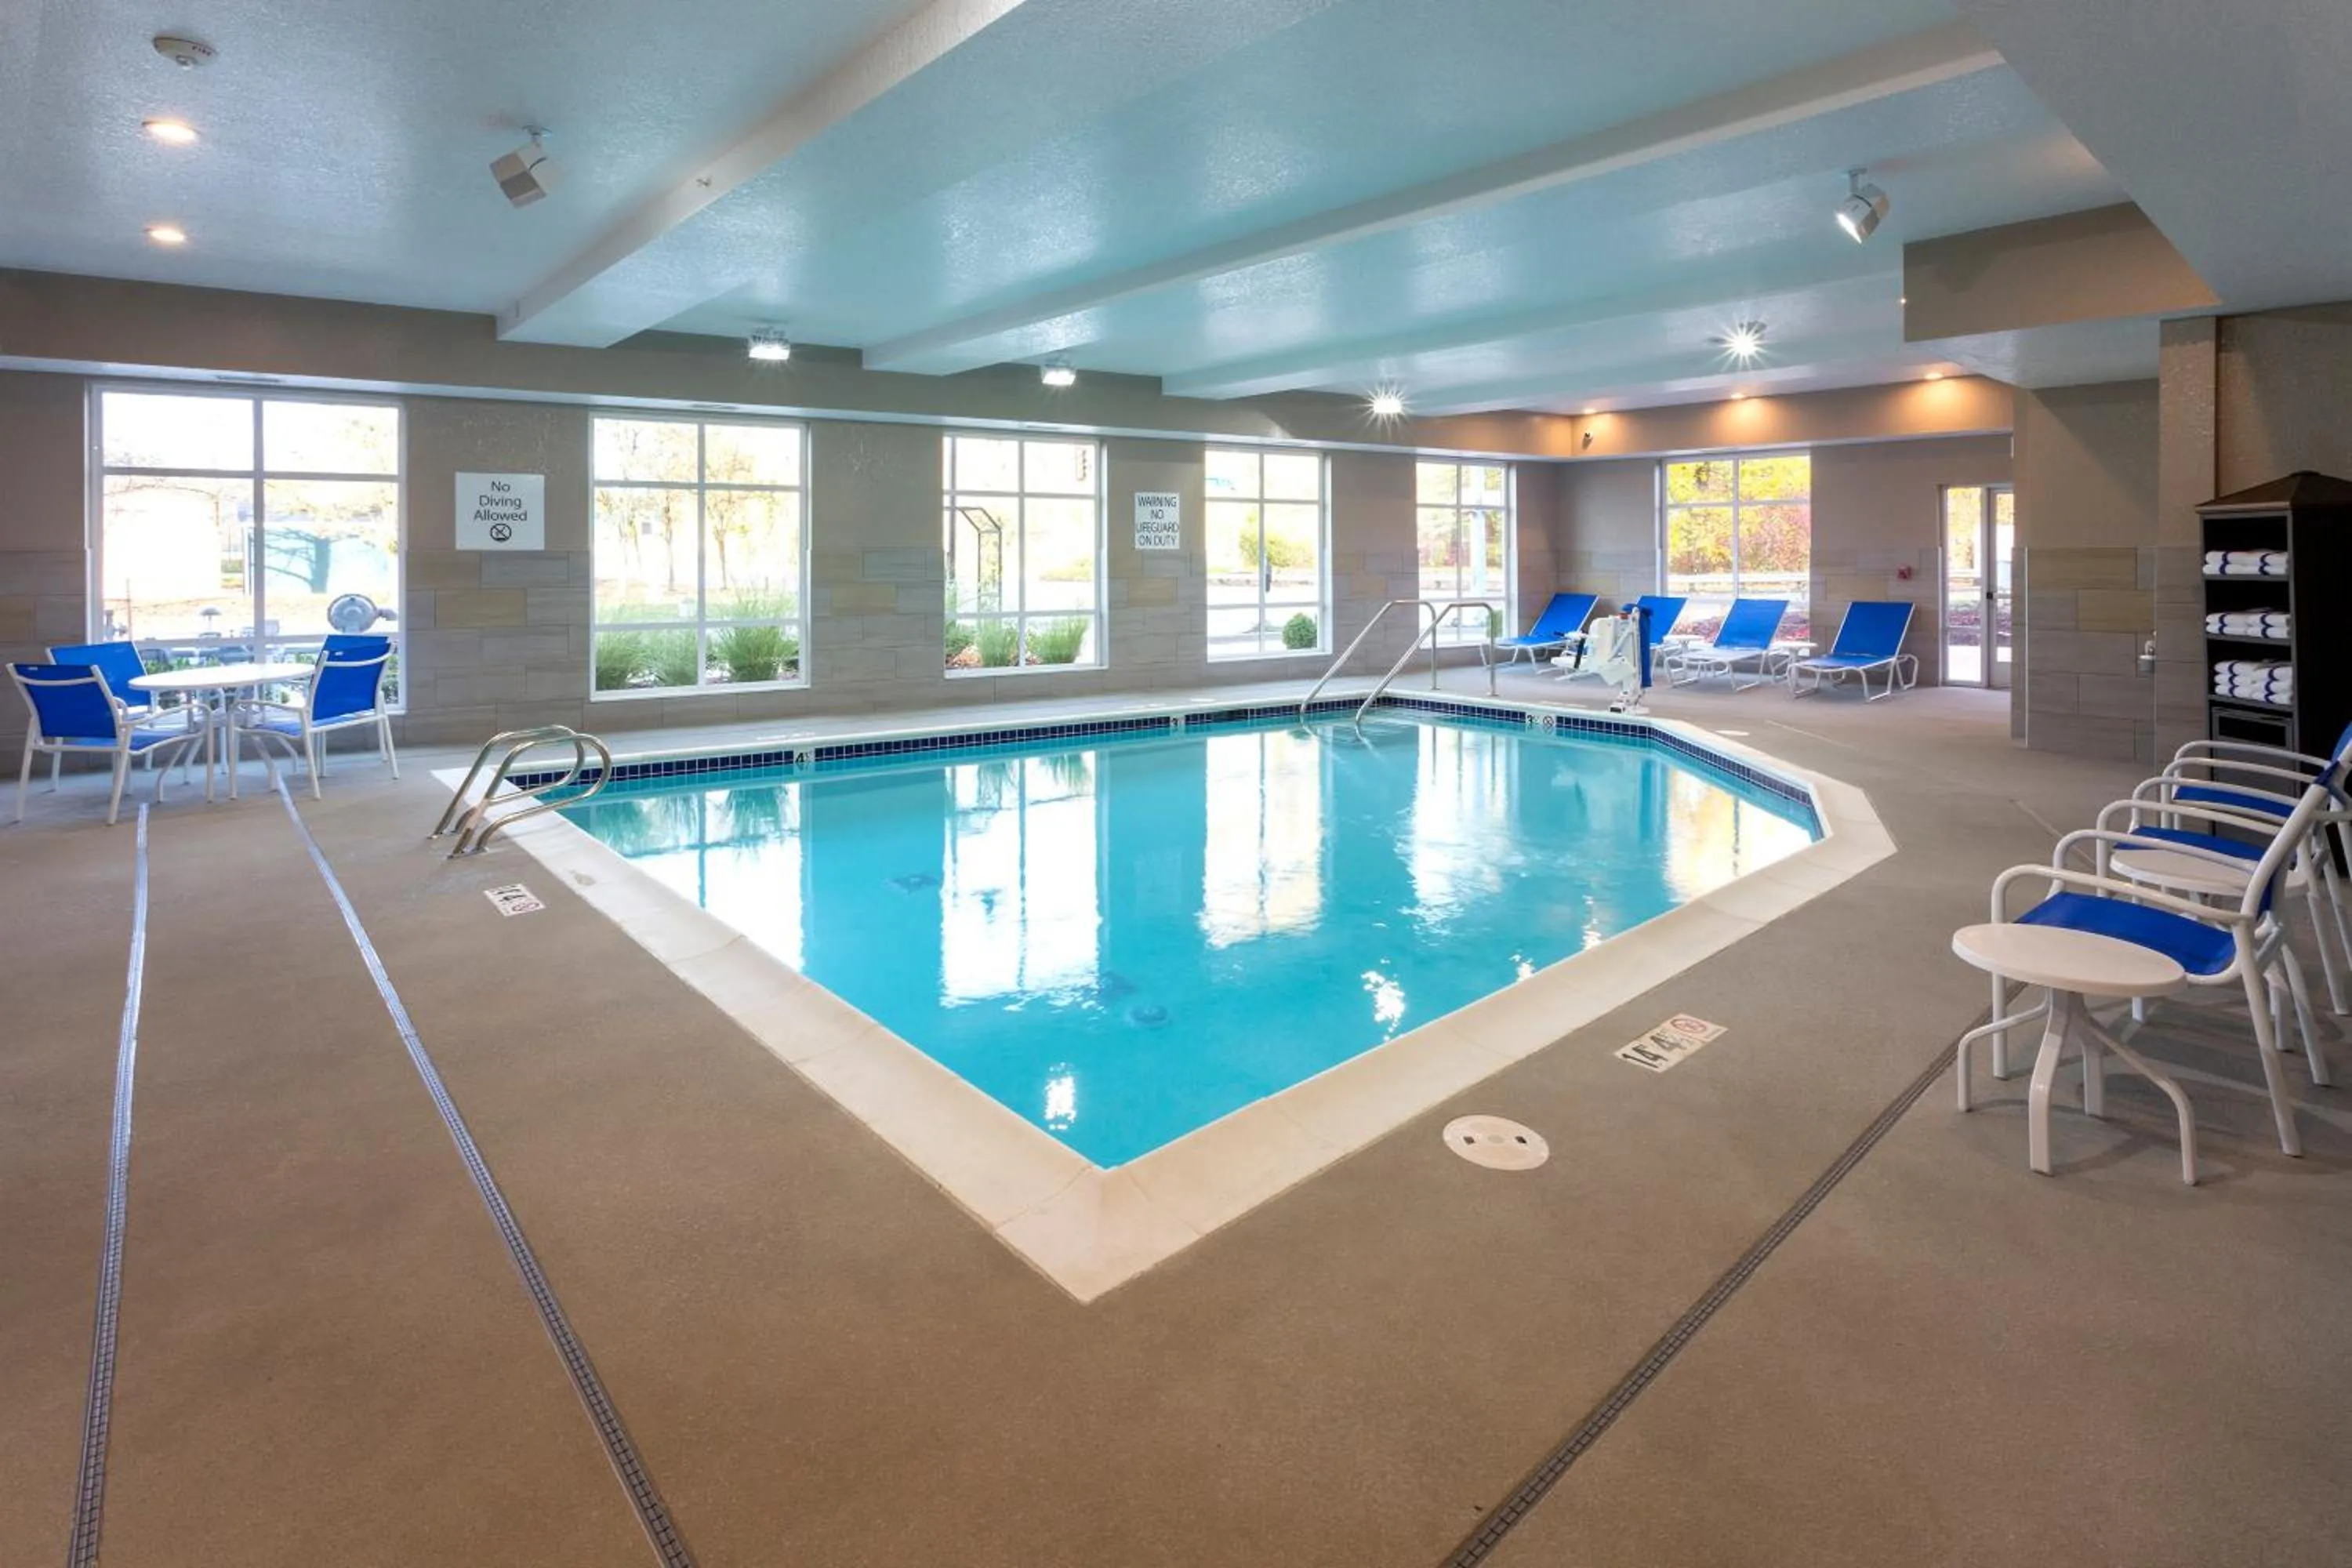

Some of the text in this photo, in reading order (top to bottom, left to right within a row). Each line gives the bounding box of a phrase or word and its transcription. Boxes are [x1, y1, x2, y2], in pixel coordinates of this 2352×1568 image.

[491, 481, 510, 492] No
[479, 495, 521, 510] Diving
[1138, 495, 1177, 507] WARNING
[474, 509, 527, 521] Allowed
[1150, 509, 1163, 520] NO
[1136, 521, 1180, 534] LIFEGUARD
[1138, 535, 1177, 546] ON DUTY
